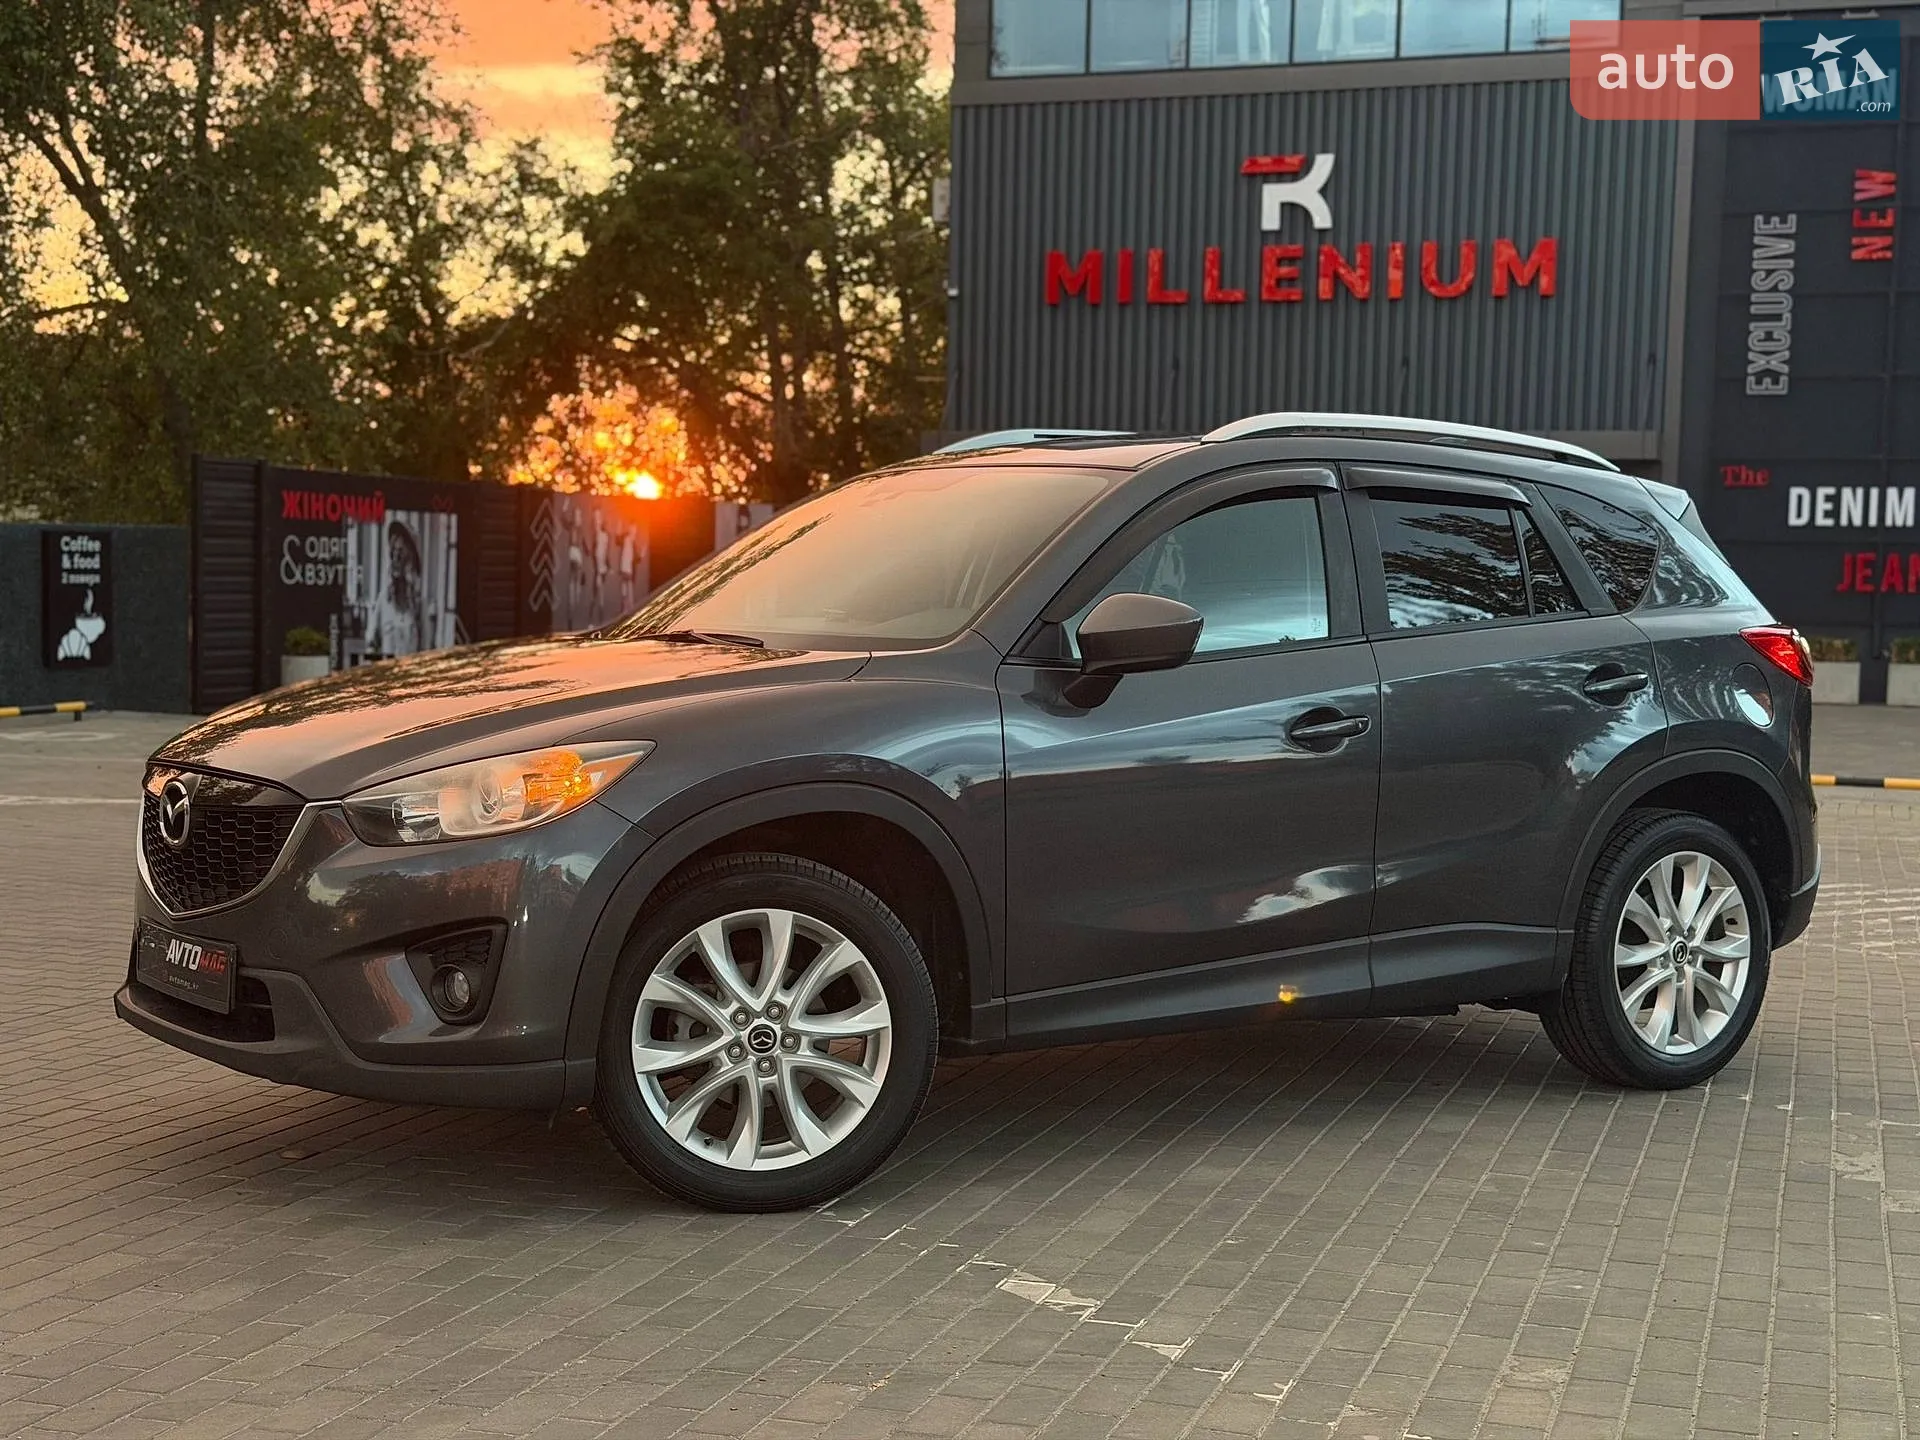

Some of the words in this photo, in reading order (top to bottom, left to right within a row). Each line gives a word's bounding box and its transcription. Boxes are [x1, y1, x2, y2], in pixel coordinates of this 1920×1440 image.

[1851, 169, 1897, 261] NEW
[1045, 237, 1558, 305] MILLENIUM
[1746, 213, 1797, 396] EXCLUSIVE
[1720, 465, 1769, 486] The
[282, 489, 385, 524] ЖІНОЧИЙ
[1788, 486, 1916, 528] DENIM
[61, 535, 102, 552] Coffee
[73, 553, 100, 569] food
